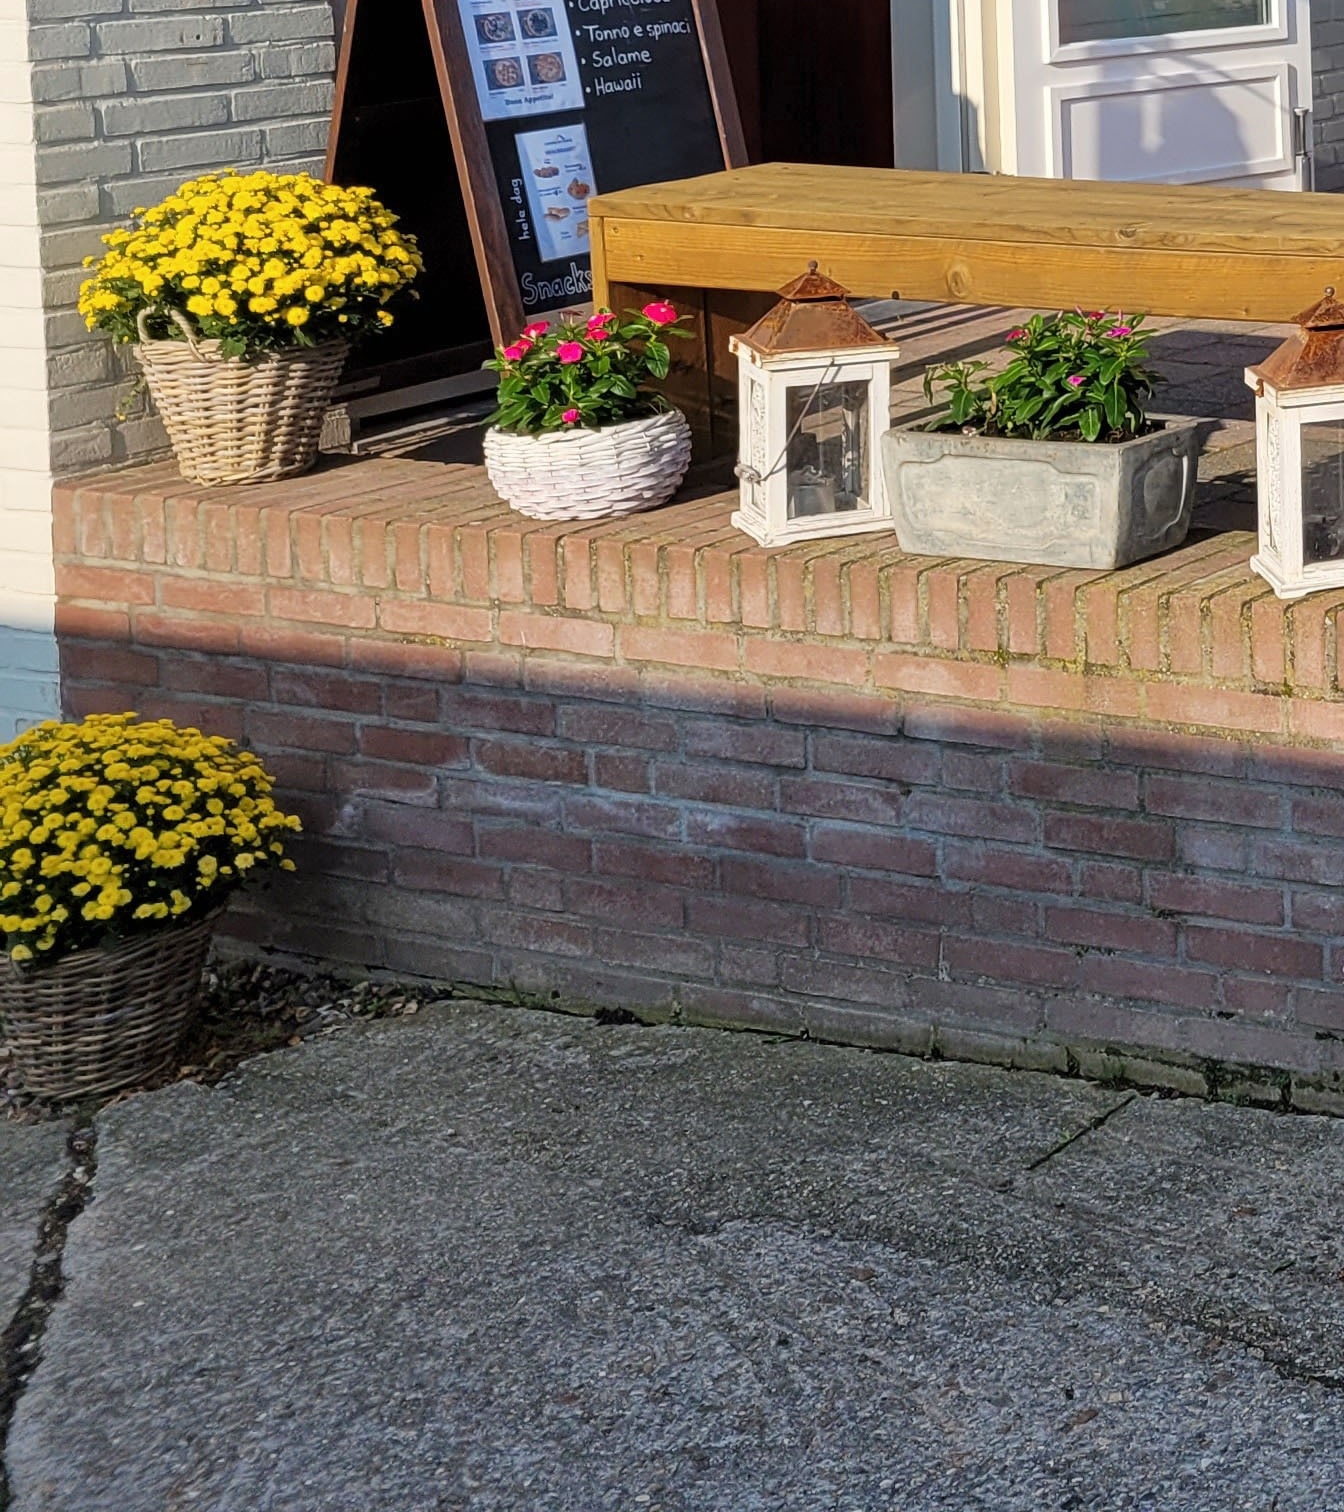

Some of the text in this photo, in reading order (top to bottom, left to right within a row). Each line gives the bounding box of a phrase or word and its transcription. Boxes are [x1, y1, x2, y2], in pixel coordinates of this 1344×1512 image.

[583, 21, 691, 44] Tonno e spinaci
[592, 46, 653, 68] Salame
[595, 73, 643, 96] Hawaii
[511, 178, 530, 240] hele dag
[521, 262, 593, 305] Snacks
